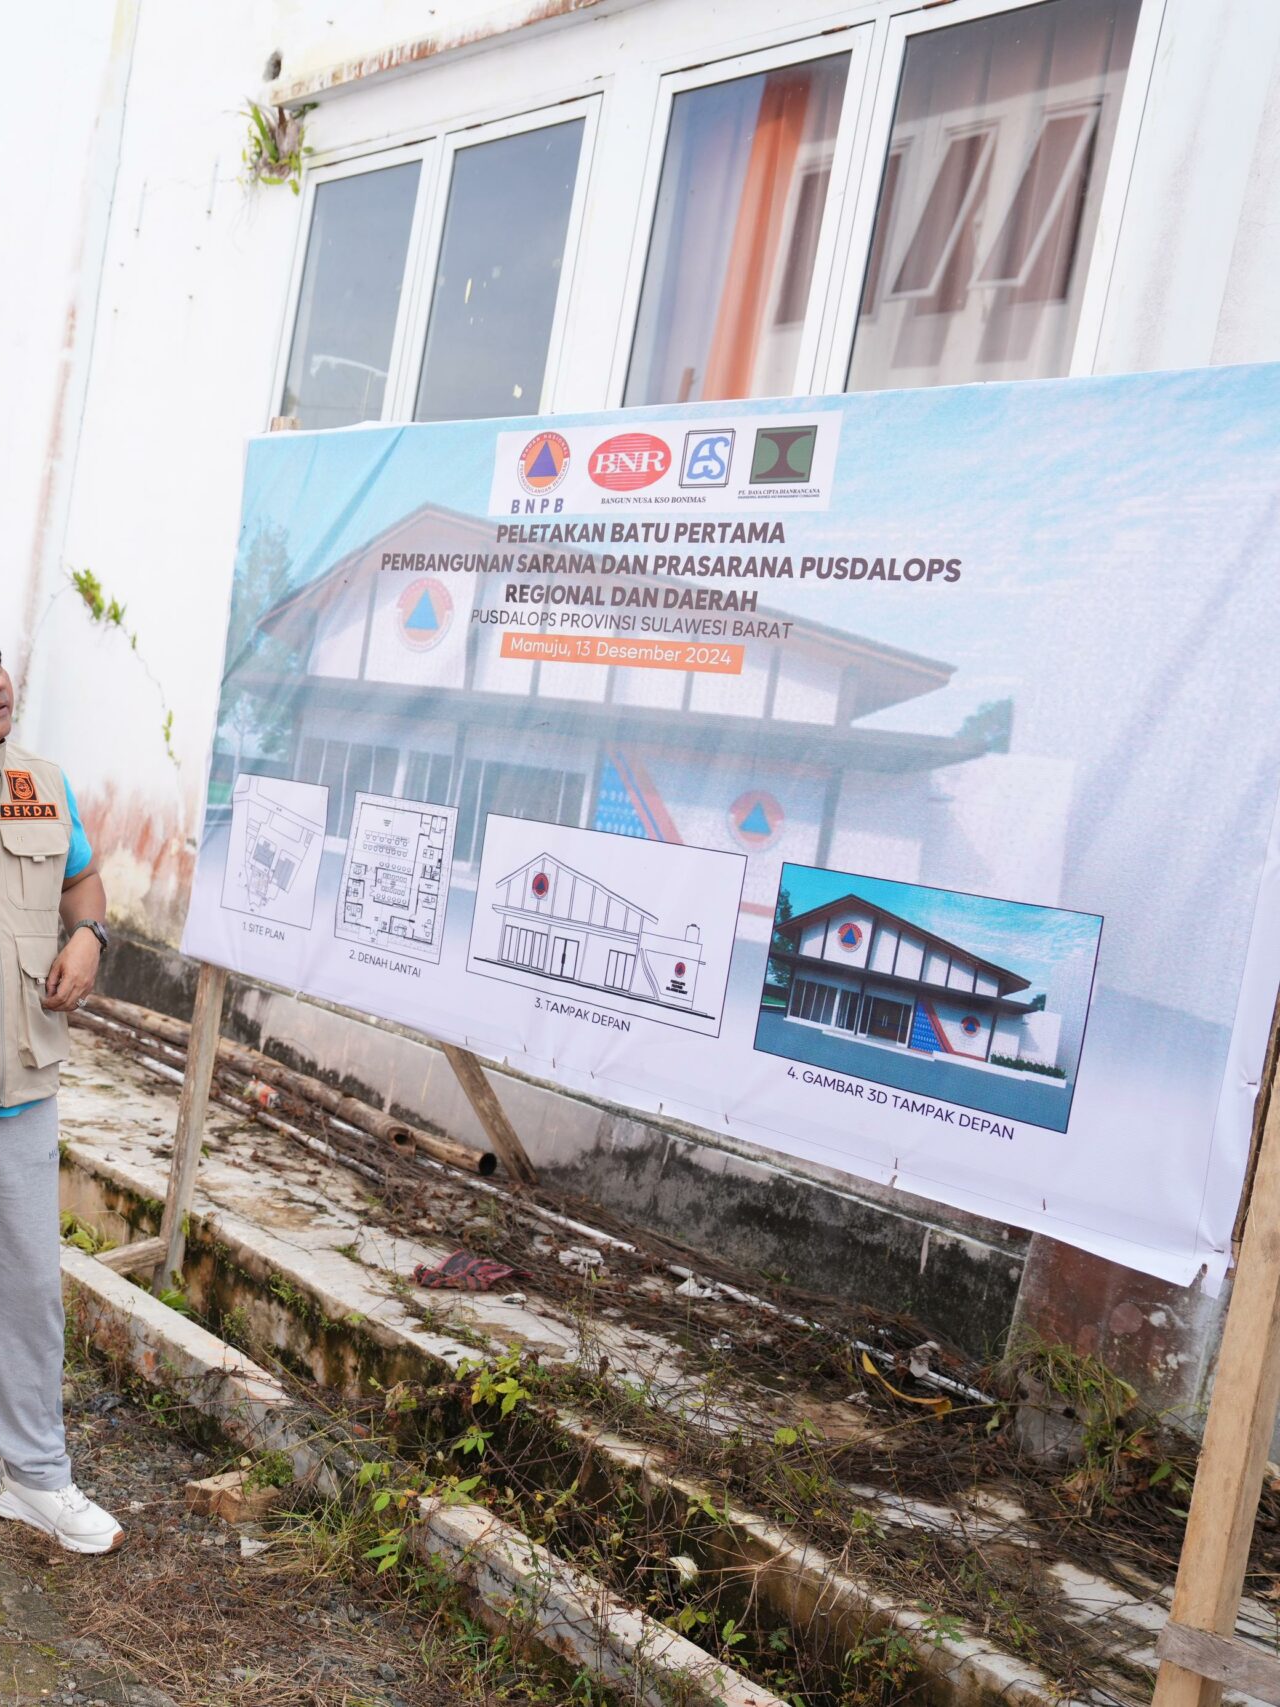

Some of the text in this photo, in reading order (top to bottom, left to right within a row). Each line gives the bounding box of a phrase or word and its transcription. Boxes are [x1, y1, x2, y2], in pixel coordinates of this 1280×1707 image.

[594, 450, 665, 474] BNR
[510, 498, 564, 514] BNPB
[601, 495, 707, 504] BANGUN NUSA KSO BONIMAS
[496, 522, 786, 543] PELETAKAN BATU PERTAMA
[381, 553, 962, 582] PEMBANGUNAN SARANA DAN PRASARANA PUSDALOPS
[505, 584, 758, 612] REGIONAL DAN DAERAH
[471, 609, 793, 639] PUSDALOPS PROVINSI SULAWESI BARAT
[510, 637, 732, 665] Mamuju, 13 Desember 2024
[3, 806, 54, 817] SEKDA
[249, 924, 264, 937] SITE
[265, 929, 285, 941] PLAN
[349, 950, 421, 978] 2. DENAH LANTAI
[534, 997, 631, 1032] 3. TAMPAK DEPAN
[787, 1066, 1015, 1140] 4. GAMBAR 3D TAMPAK DEPAN
